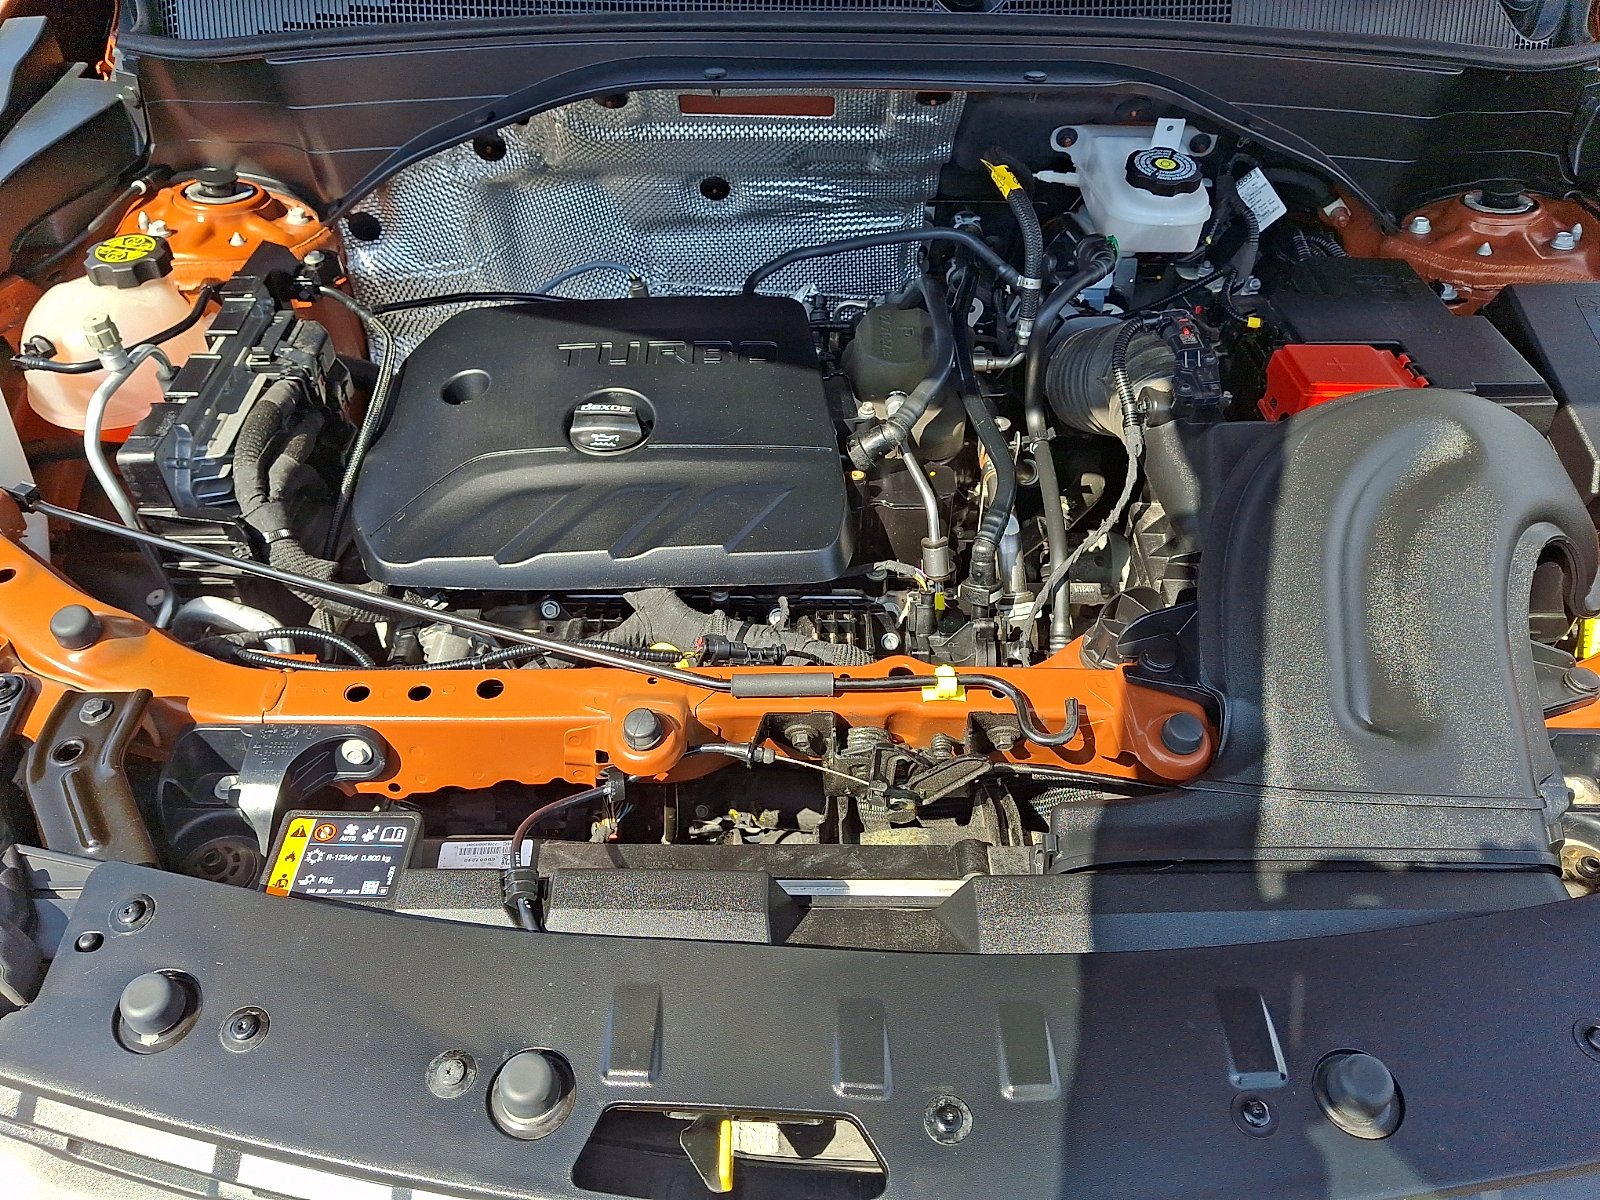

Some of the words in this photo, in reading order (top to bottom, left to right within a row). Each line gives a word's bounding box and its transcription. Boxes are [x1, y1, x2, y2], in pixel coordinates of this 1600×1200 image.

[557, 340, 778, 366] TURBO
[580, 402, 635, 413] dexos
[326, 853, 359, 863] R-1234yf
[381, 855, 392, 864] kg
[318, 876, 334, 885] PAG
